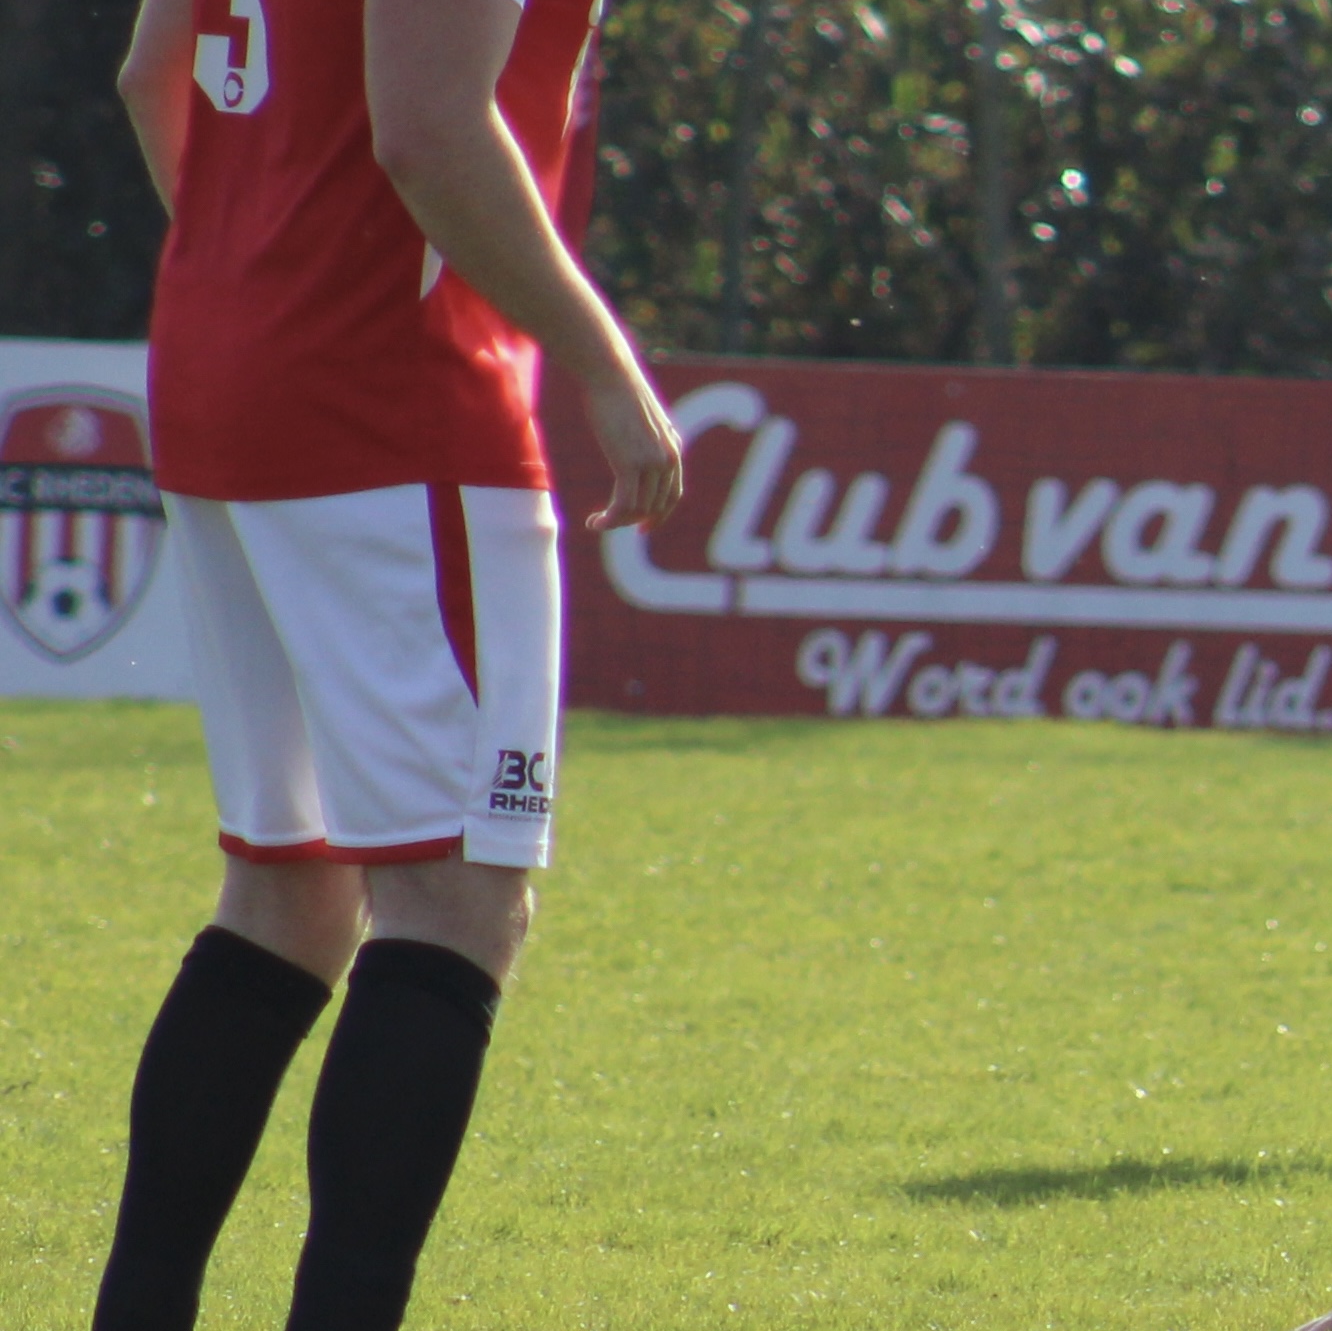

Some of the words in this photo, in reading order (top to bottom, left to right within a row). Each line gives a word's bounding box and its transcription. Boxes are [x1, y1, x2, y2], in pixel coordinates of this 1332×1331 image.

[602, 380, 1001, 616] Club
[796, 628, 1059, 719] Word
[1062, 639, 1198, 727] ook
